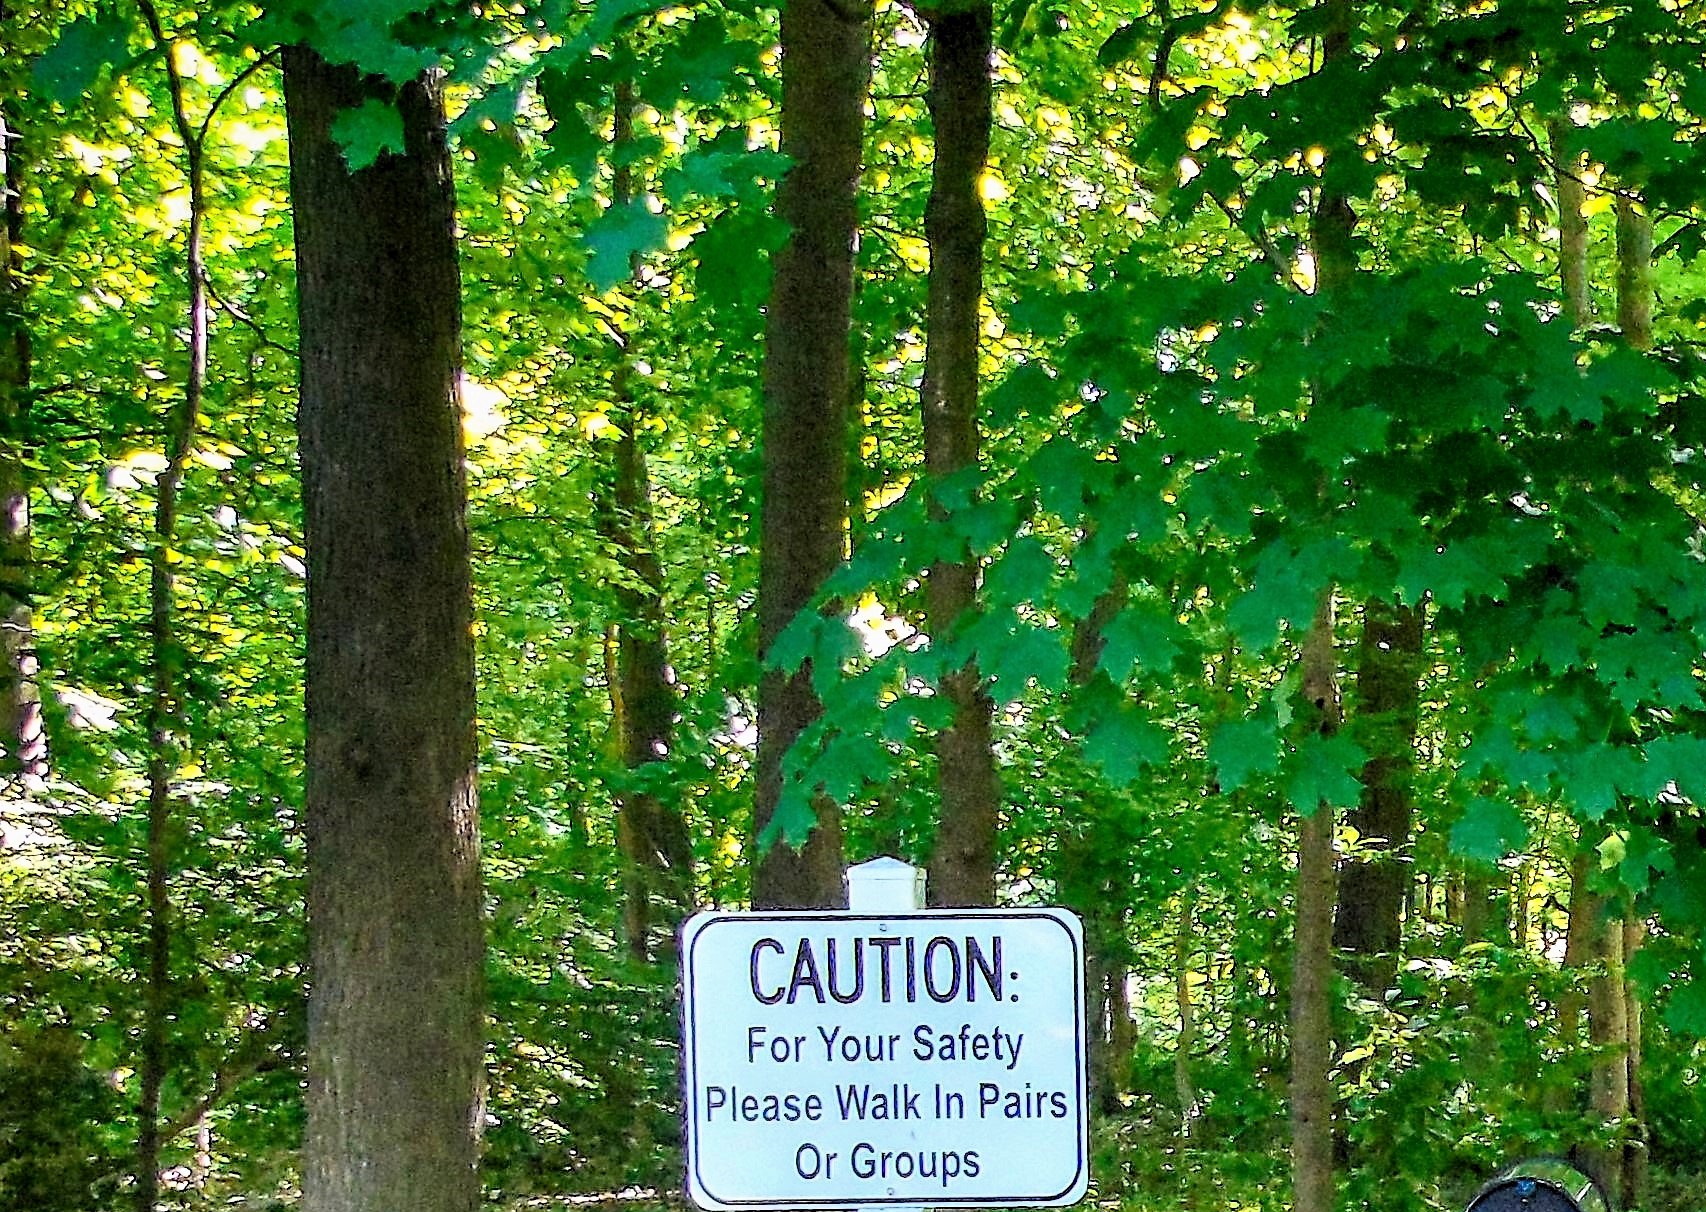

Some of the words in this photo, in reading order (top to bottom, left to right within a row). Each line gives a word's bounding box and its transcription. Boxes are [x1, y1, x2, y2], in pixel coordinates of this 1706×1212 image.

[750, 936, 1019, 1005] CAUTION:
[749, 1027, 806, 1063] For
[817, 1026, 900, 1061] Your
[913, 1024, 1023, 1070] Safety
[707, 1086, 822, 1121] Please
[836, 1084, 921, 1120] Walk
[936, 1084, 963, 1118] In
[980, 1083, 1067, 1118] Pairs
[796, 1143, 837, 1179] Or
[851, 1143, 979, 1187] Groups
